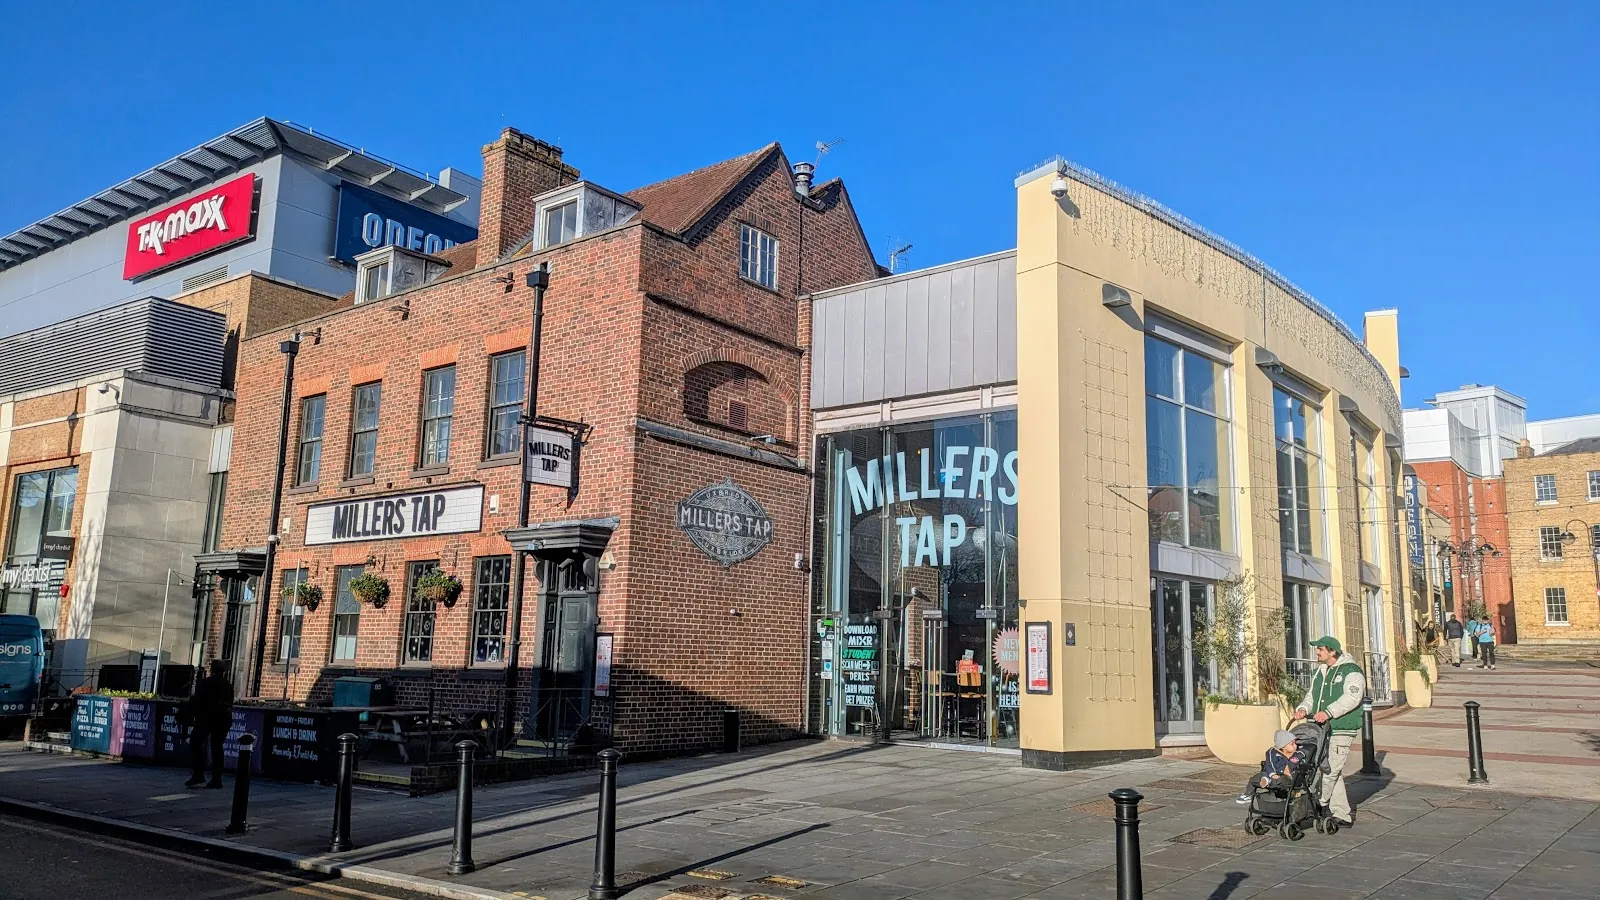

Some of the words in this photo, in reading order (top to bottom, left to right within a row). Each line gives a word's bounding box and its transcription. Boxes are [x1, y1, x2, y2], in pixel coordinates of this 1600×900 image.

[362, 212, 462, 255] ODEO
[529, 441, 570, 460] MILLERS
[541, 458, 559, 472] TAP
[846, 446, 1018, 516] MILLERS
[332, 498, 407, 540] MILLERS
[410, 494, 446, 534] TAP
[681, 506, 740, 532] MILLERS
[746, 517, 770, 536] TAP
[896, 514, 966, 568] TAP
[844, 624, 878, 634] DOWNLOAD
[0, 643, 32, 656] signs
[842, 648, 876, 659] STUDENT
[1001, 651, 1019, 661] MEN
[850, 672, 870, 681] DEALS
[845, 684, 857, 694] EARN
[858, 684, 876, 694] POINTS
[1008, 681, 1016, 692] IS
[846, 696, 855, 704] GET
[856, 696, 874, 705] PRIZES
[76, 715, 88, 723] PIZZA
[94, 717, 107, 726] BURGER
[128, 712, 141, 720] WING
[276, 716, 294, 724] MONDAY
[298, 716, 314, 726] FRIDAY
[272, 727, 292, 739] LUNCH
[298, 729, 317, 742] DRINK
